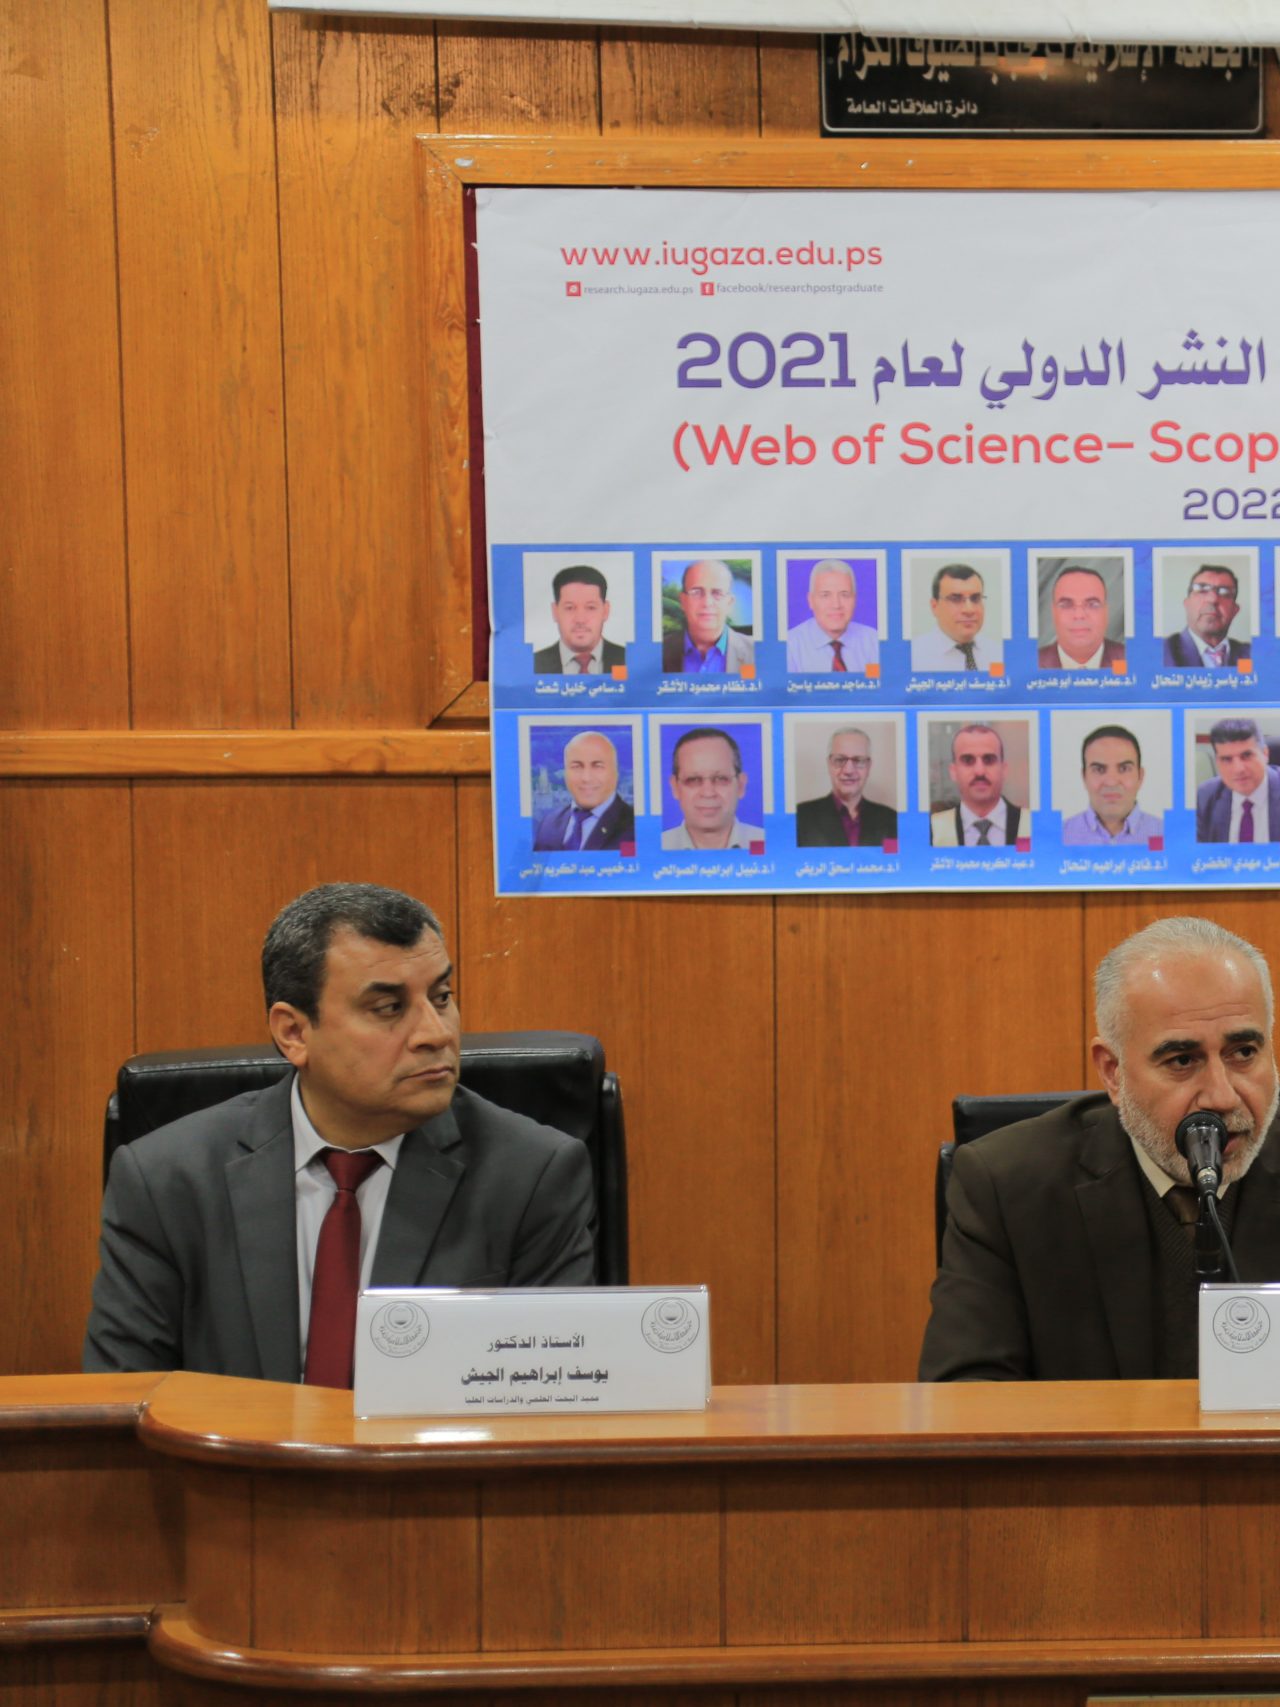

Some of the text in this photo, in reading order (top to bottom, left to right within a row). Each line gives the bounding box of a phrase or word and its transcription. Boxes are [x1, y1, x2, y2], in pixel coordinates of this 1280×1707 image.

[561, 241, 882, 275] www.iugaza.edu.ps
[584, 284, 693, 296] research.iugaza.edu.ps
[677, 332, 856, 389] 2021
[1138, 330, 1265, 400] النشر
[873, 340, 964, 404] لعام
[980, 339, 1125, 409] الدولي
[673, 421, 816, 472] (Web
[832, 423, 885, 465] of
[561, 681, 587, 696] خليل
[689, 683, 721, 695] محمود
[814, 681, 840, 691] محمد
[1072, 677, 1099, 687] محمد
[486, 1335, 536, 1352] الدكتور
[461, 1366, 608, 1387] يوسف إبراهيم الجيش
